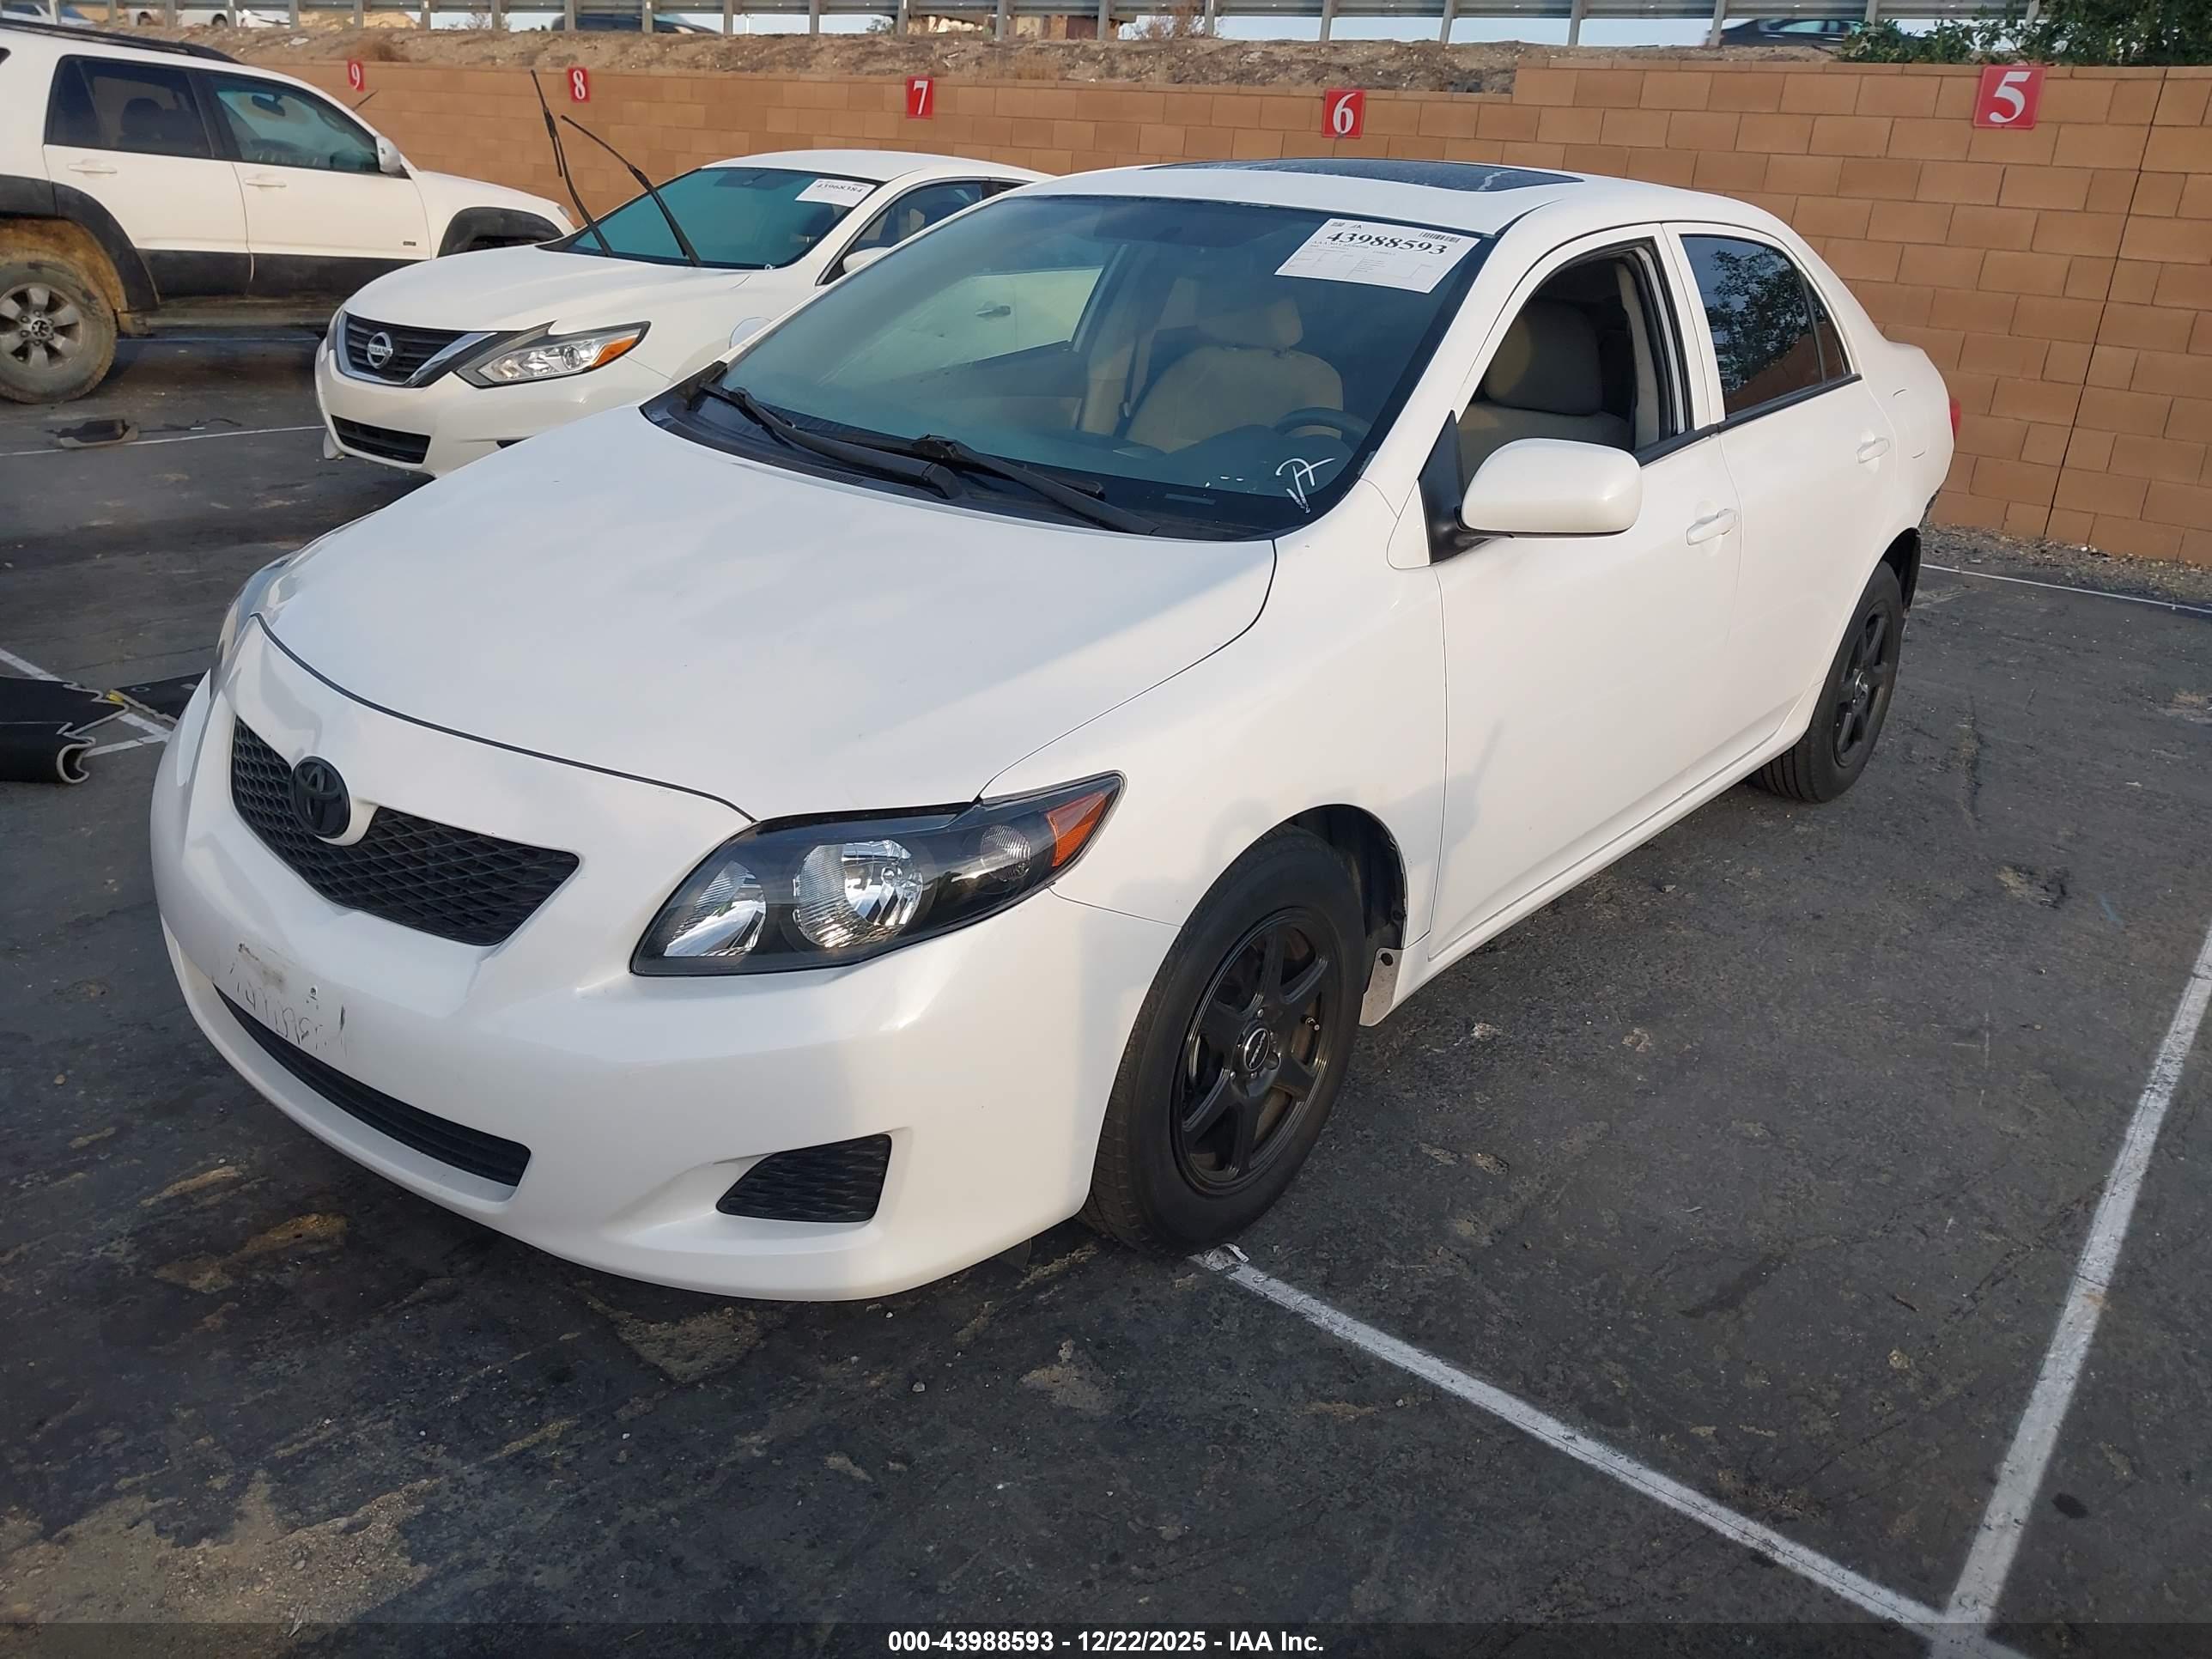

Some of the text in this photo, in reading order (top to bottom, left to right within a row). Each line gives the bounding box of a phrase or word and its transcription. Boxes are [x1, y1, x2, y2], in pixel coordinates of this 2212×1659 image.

[350, 63, 362, 89] 9
[572, 70, 586, 100] 8
[914, 80, 928, 114] 7
[1990, 71, 2032, 124] 5
[1333, 93, 1355, 135] 6
[1326, 231, 1449, 256] 43988593
